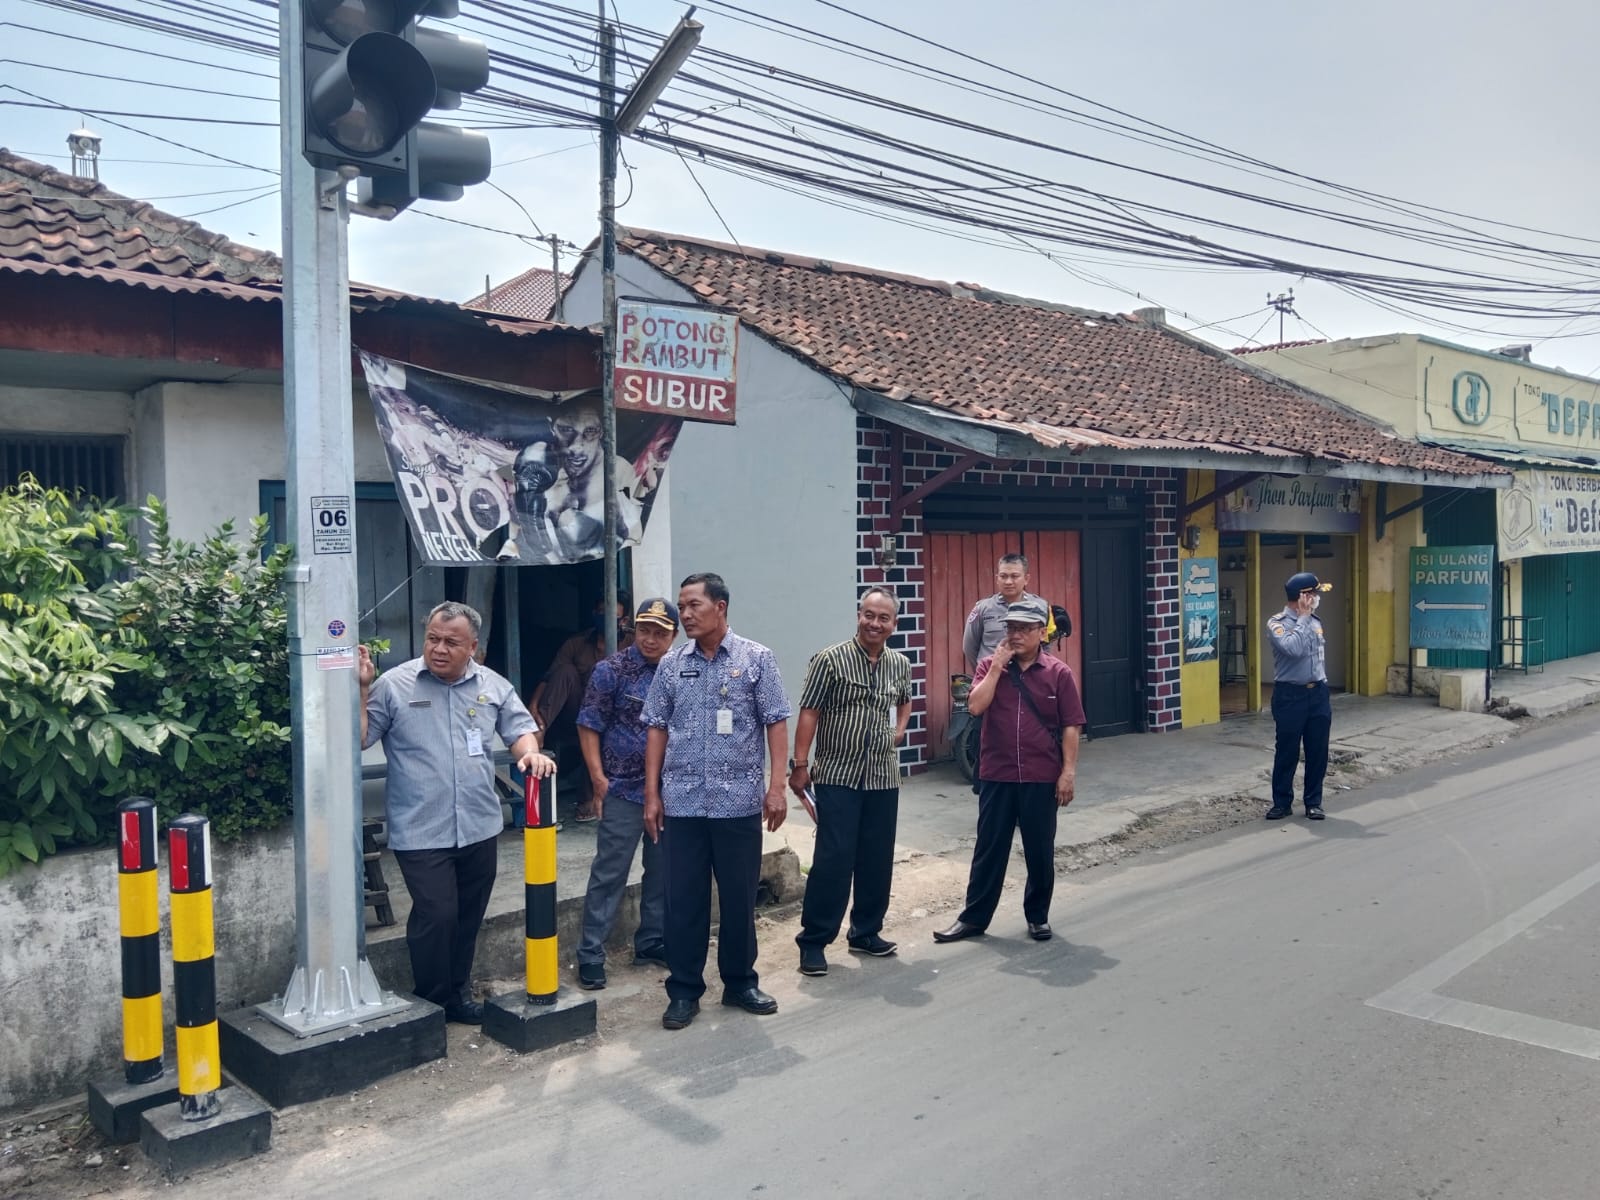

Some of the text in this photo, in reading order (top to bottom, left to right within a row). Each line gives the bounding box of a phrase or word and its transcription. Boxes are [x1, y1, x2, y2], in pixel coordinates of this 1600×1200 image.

[622, 314, 726, 344] POTONG
[622, 339, 727, 371] RAMBUT
[623, 375, 730, 412] SUBUR
[1523, 383, 1541, 397] TOKO
[1289, 481, 1334, 515] Parfum
[319, 509, 347, 527] 06
[421, 531, 484, 562] NEVER
[1416, 553, 1488, 566] ISI ULANG
[1415, 570, 1489, 585] PARFUM
